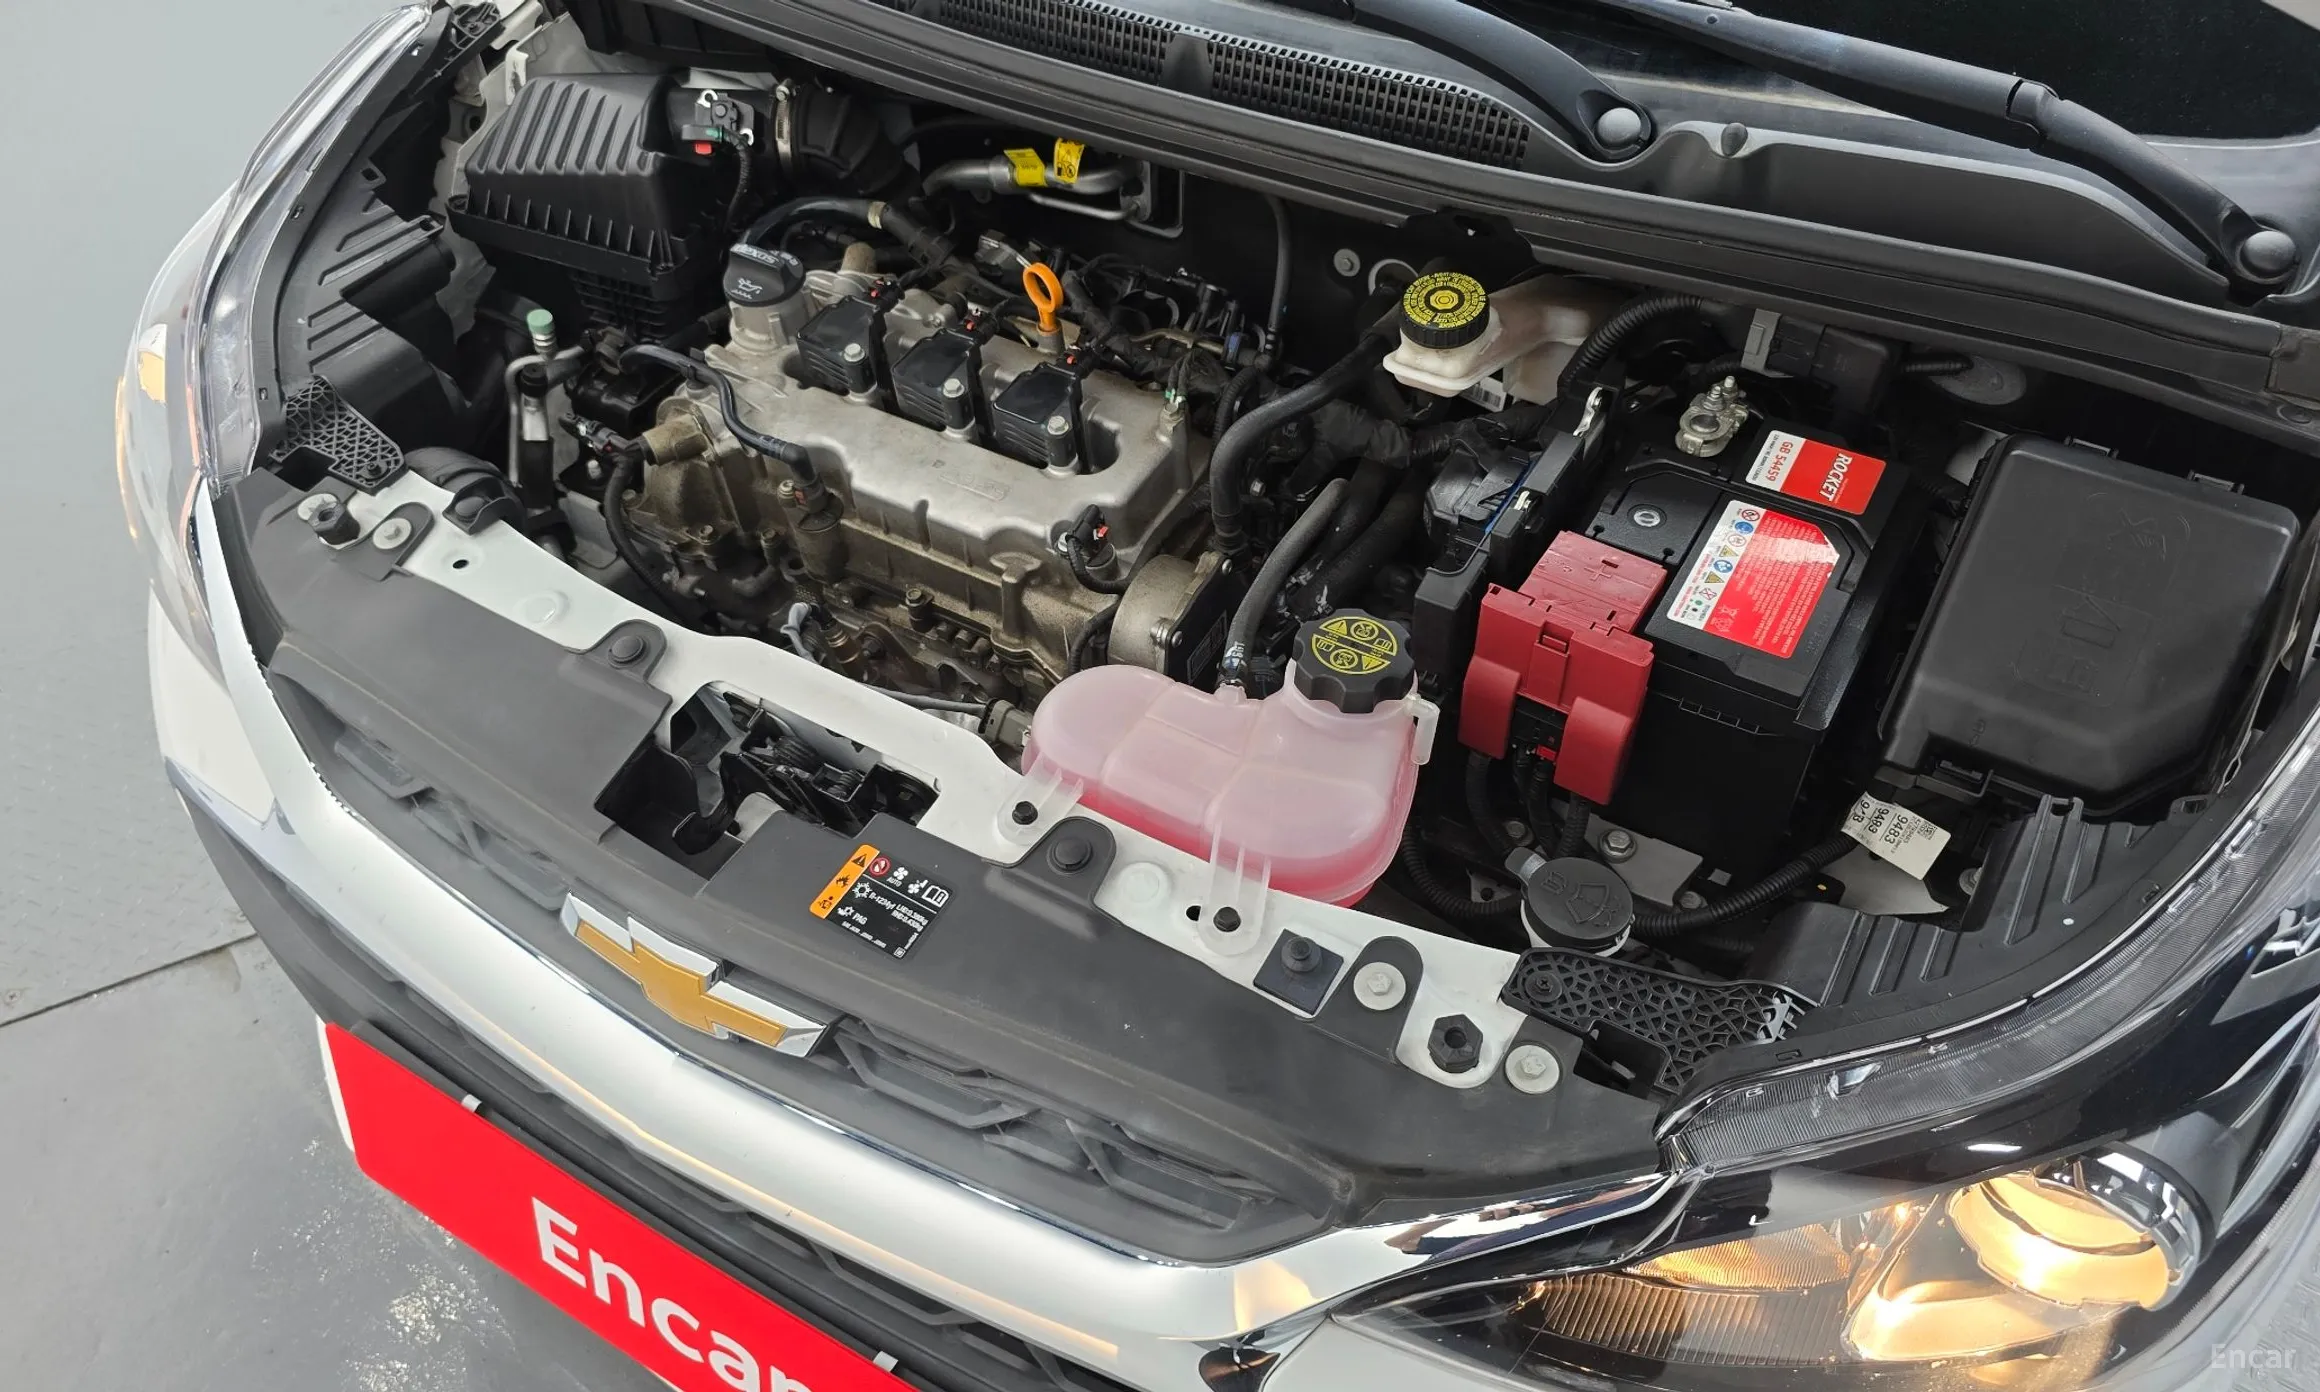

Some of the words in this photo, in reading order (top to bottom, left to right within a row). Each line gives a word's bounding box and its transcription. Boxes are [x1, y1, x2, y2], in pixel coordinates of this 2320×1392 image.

[1779, 441, 1794, 455] GB
[1765, 453, 1787, 482] 54459
[1819, 452, 1853, 502] ROCKET
[1868, 807, 1890, 834] 9483
[1884, 814, 1909, 845] 9483
[852, 912, 868, 925] PAG
